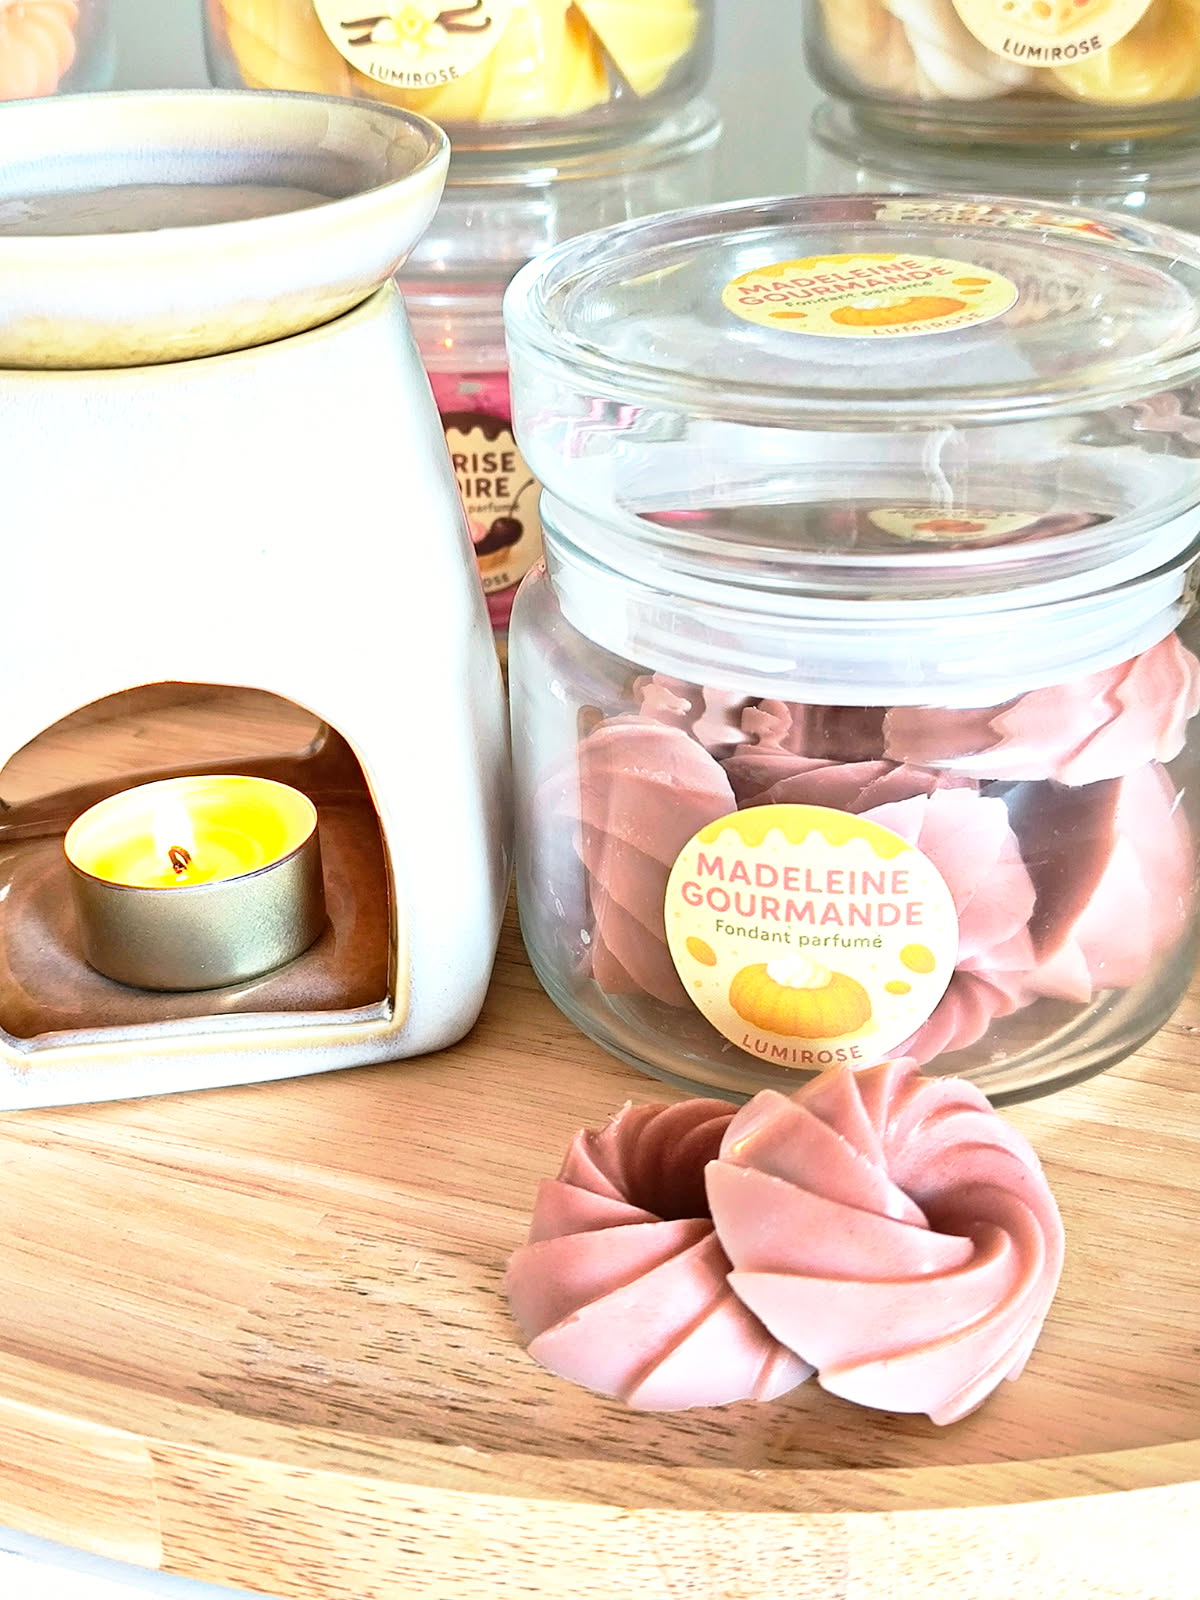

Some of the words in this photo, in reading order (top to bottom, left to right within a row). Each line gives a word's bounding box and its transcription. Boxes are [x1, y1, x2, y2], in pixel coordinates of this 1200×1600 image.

[1002, 36, 1102, 60] LUMIROSE
[369, 63, 459, 86] LUMIROSE
[738, 260, 923, 295] MADELEINE
[738, 266, 953, 306] GOURMANDE
[784, 292, 856, 308] Fondant
[872, 311, 985, 335] LUMIROSE
[452, 452, 515, 474] RISE
[458, 478, 510, 498] IRE
[697, 852, 909, 894] MADELEINE
[681, 881, 924, 927] GOURMANDE
[715, 919, 792, 944] Fondant
[799, 933, 883, 949] parfumé
[742, 1034, 863, 1064] LUMIROSE
